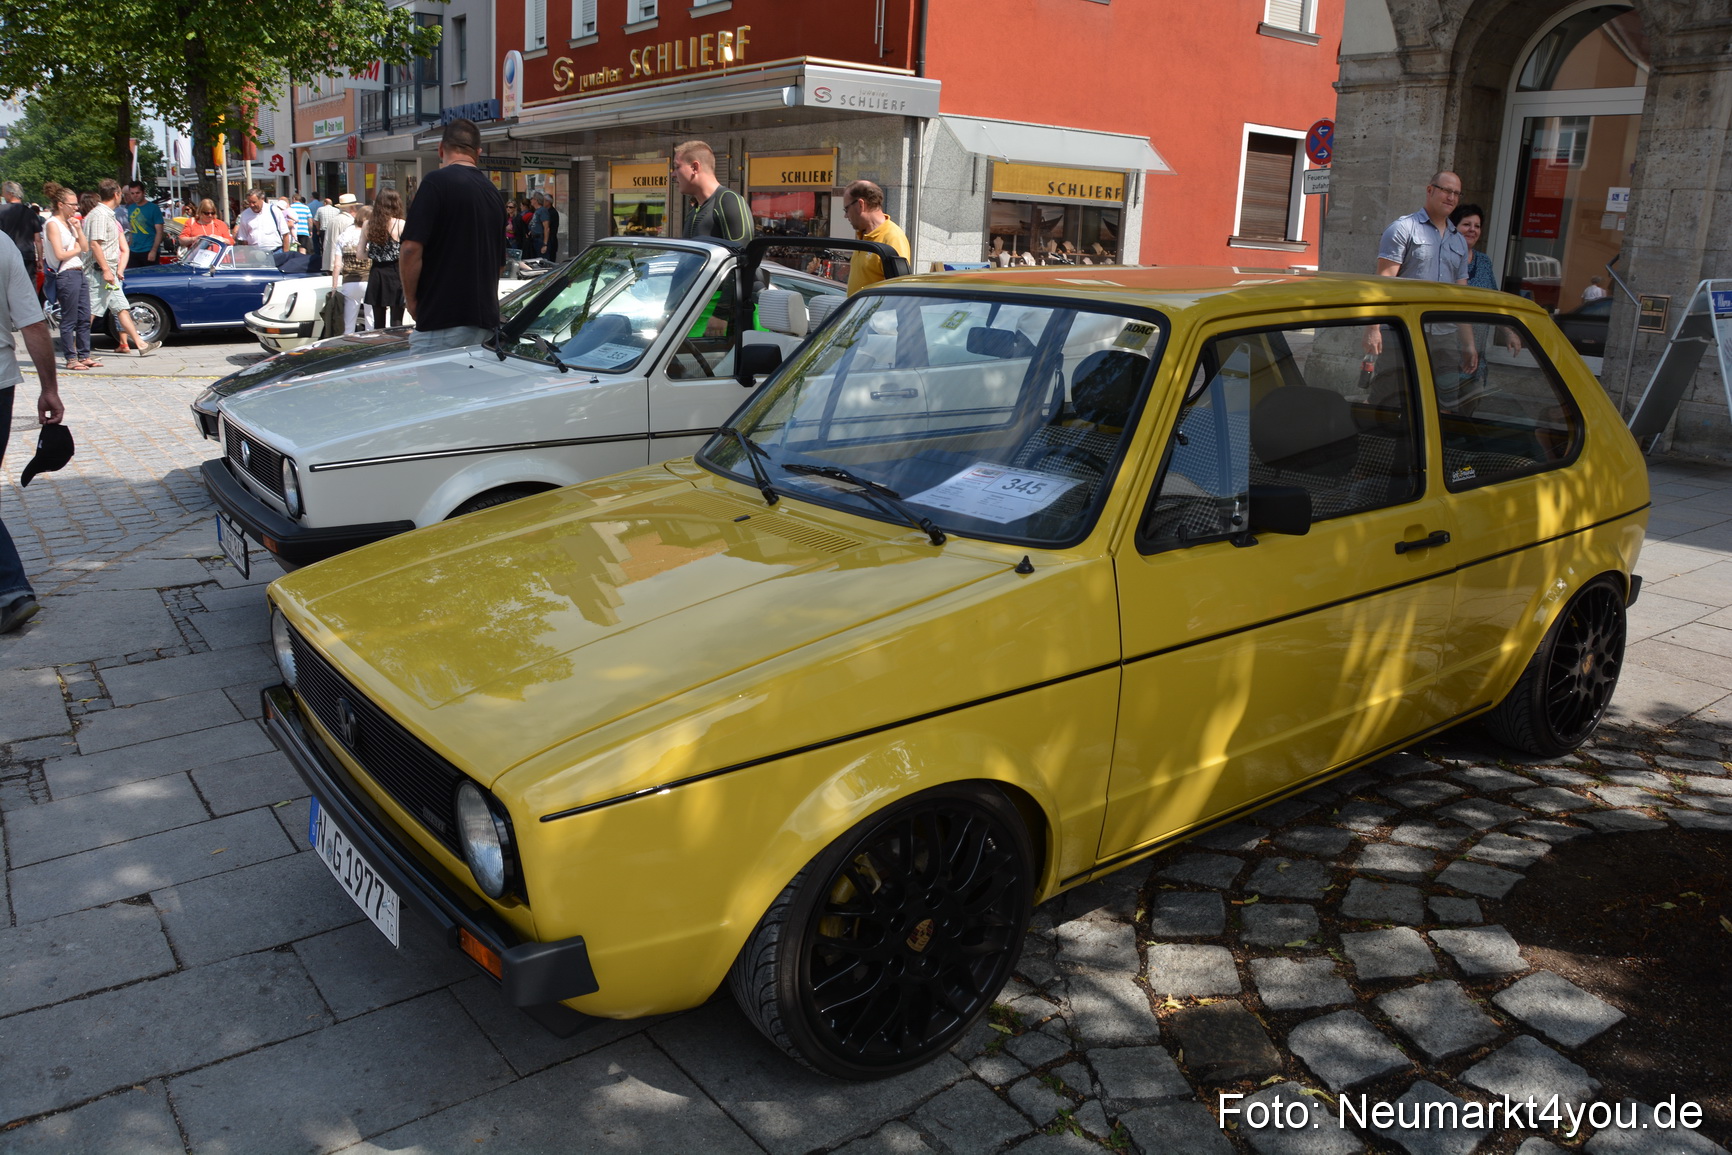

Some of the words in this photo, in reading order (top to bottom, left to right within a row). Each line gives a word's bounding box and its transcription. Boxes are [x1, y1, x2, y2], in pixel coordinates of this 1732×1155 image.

[630, 25, 751, 79] SCHLIERF
[840, 94, 906, 111] SCHLIERF
[523, 156, 540, 165] NZ
[632, 175, 668, 187] SCHLIERF
[781, 170, 833, 183] SCHLIERF
[1047, 180, 1122, 199] SCHLIERF
[1312, 182, 1330, 190] zufahr
[1124, 323, 1154, 336] ADAC
[1001, 478, 1048, 495] 345
[332, 830, 342, 875] G
[344, 847, 385, 920] 1977
